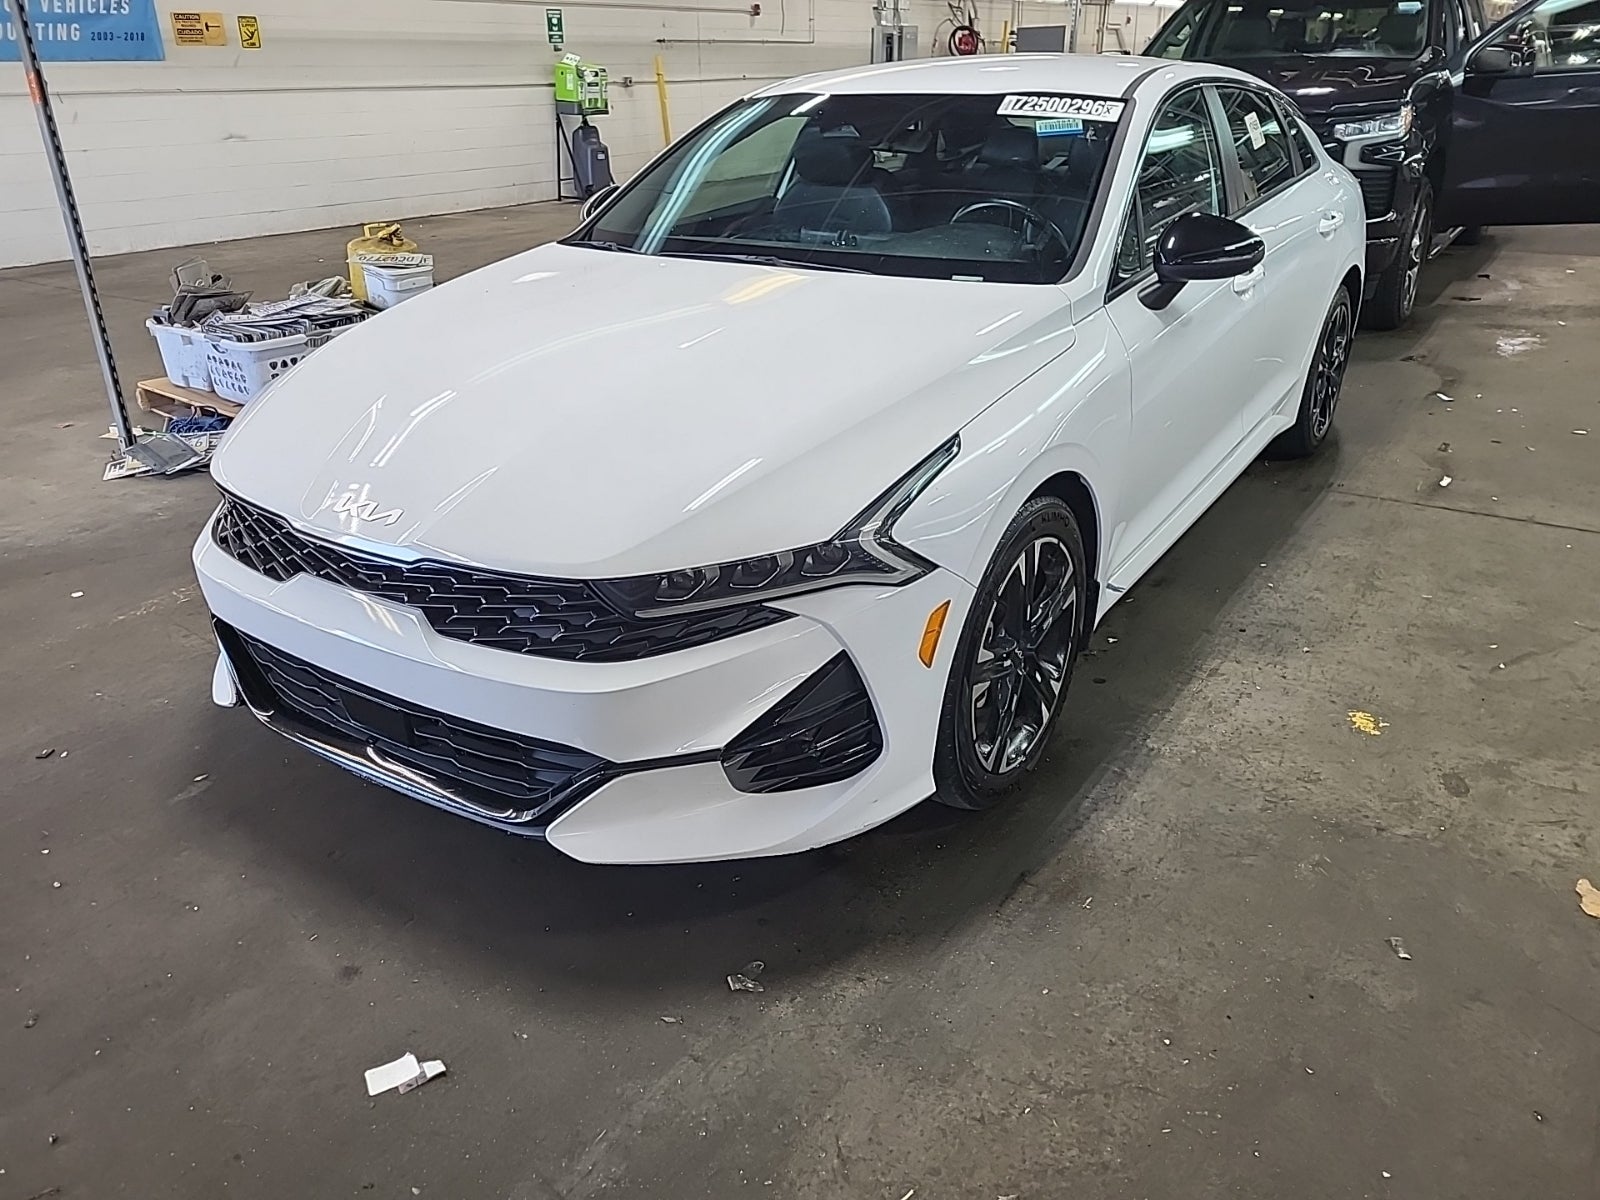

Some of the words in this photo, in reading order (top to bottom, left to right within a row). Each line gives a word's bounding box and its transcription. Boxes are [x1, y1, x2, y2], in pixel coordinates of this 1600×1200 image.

[41, 0, 130, 15] VEHICLES
[0, 22, 81, 41] UTING
[1013, 95, 1105, 116] 72500296
